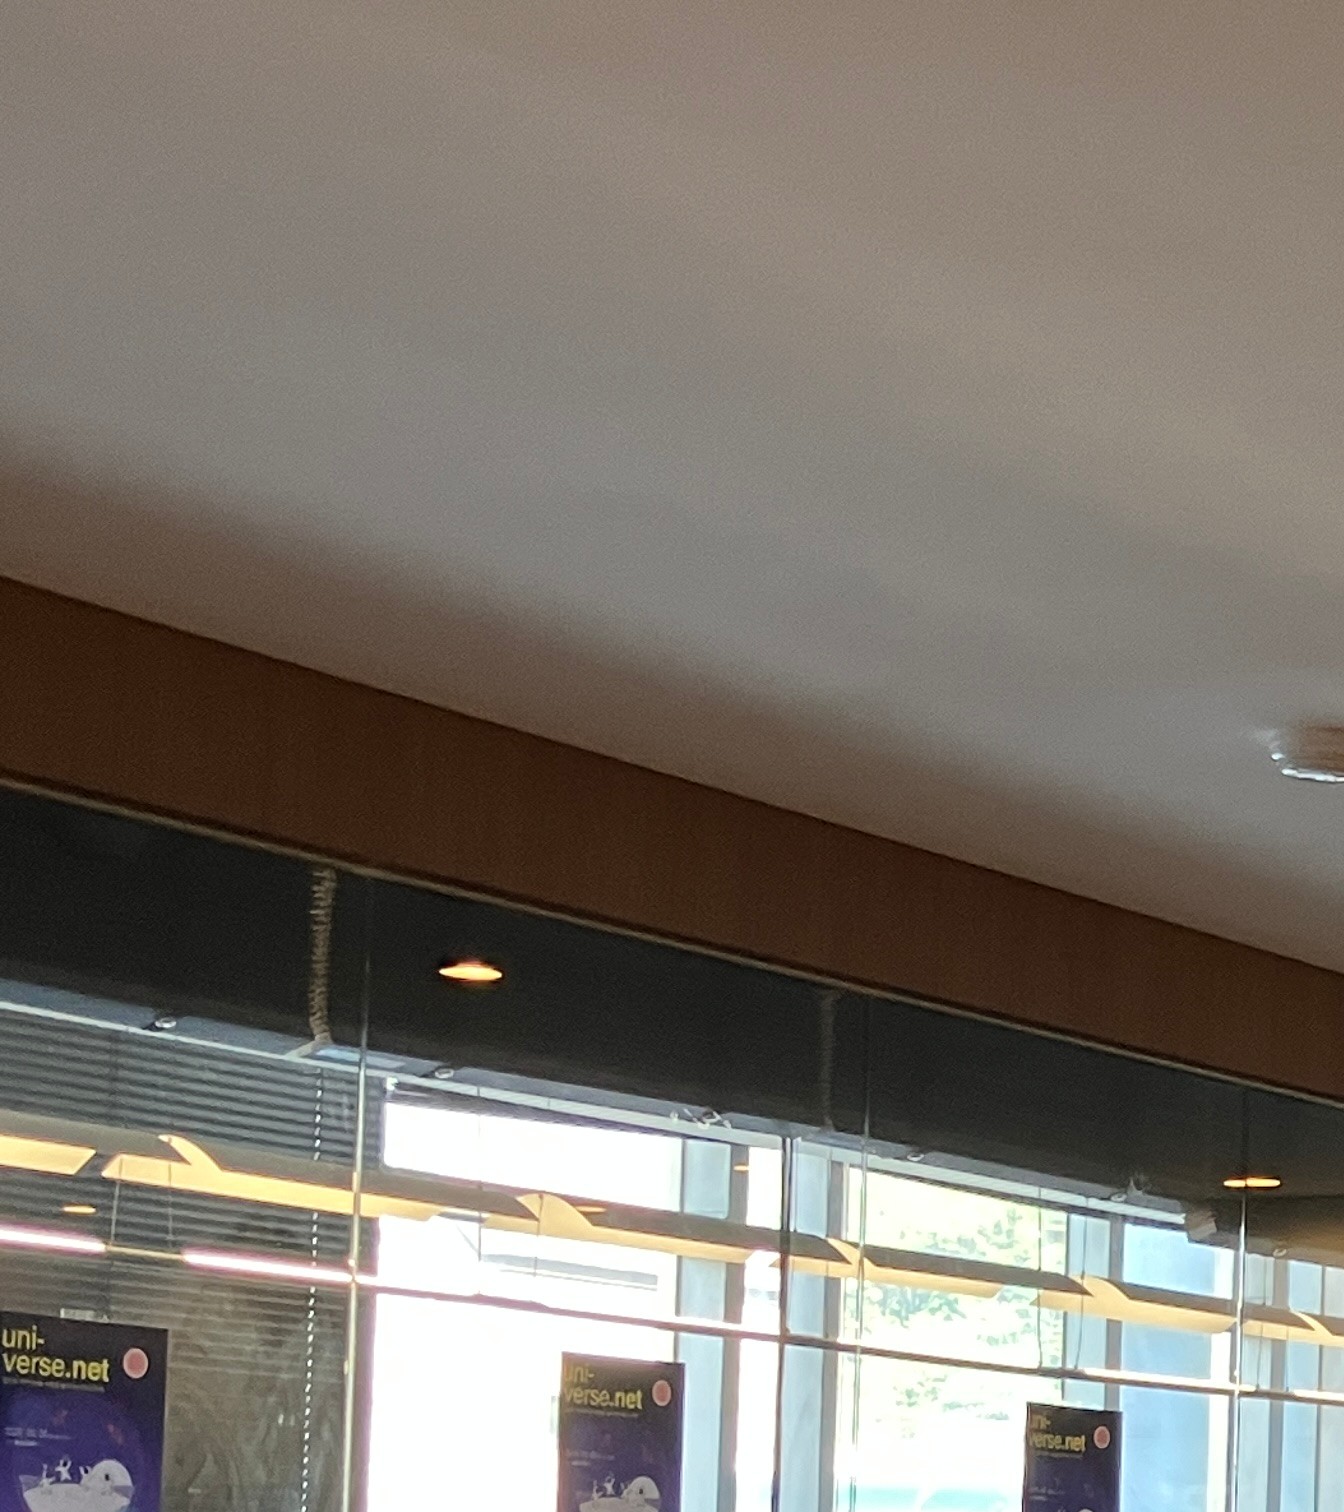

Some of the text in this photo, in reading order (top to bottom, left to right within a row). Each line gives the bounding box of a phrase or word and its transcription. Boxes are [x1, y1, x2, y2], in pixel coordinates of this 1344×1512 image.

[2, 1324, 46, 1350] uni-
[2, 1352, 110, 1383] verse.net
[564, 1383, 643, 1410] verse.net
